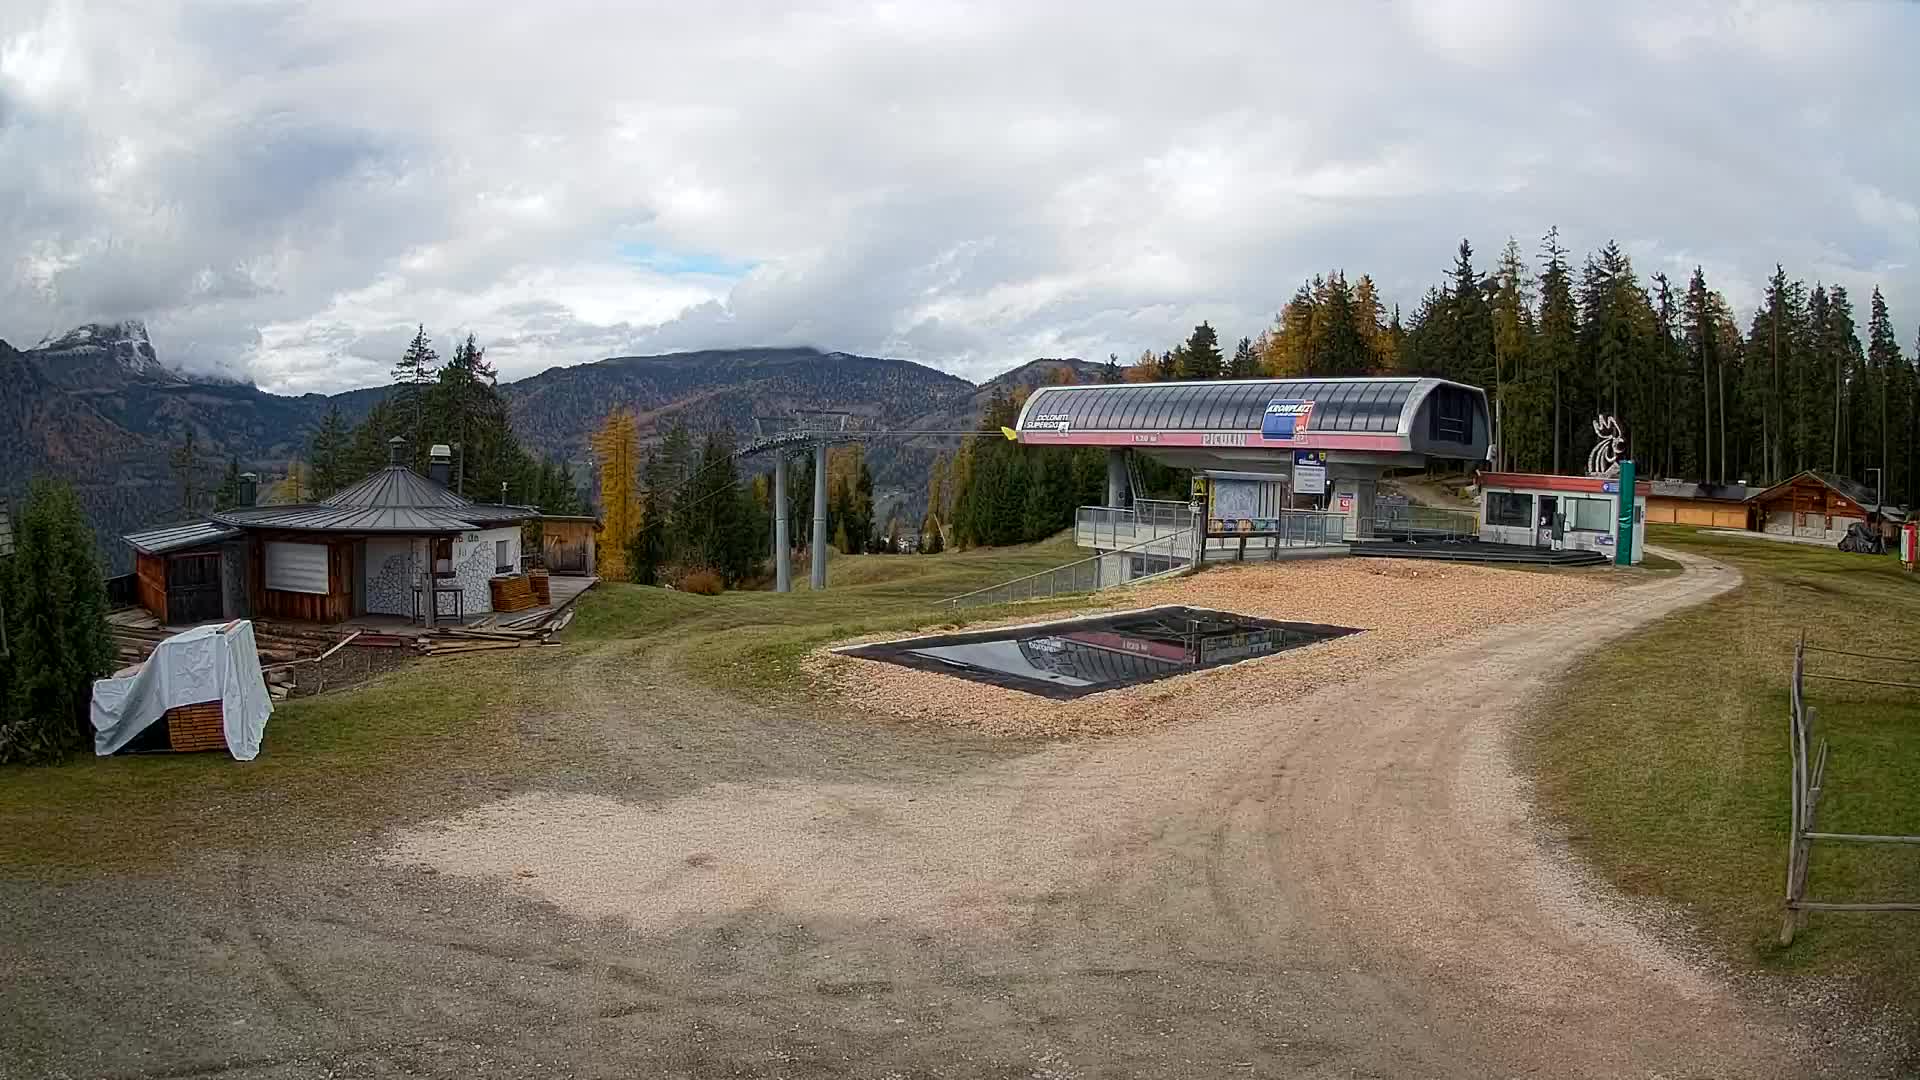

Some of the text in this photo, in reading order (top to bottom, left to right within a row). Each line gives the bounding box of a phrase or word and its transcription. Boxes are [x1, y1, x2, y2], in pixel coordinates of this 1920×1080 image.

[1266, 404, 1313, 413] KRONPLATZ
[1026, 421, 1059, 429] SUPERSKI
[1202, 433, 1247, 446] PICULIN
